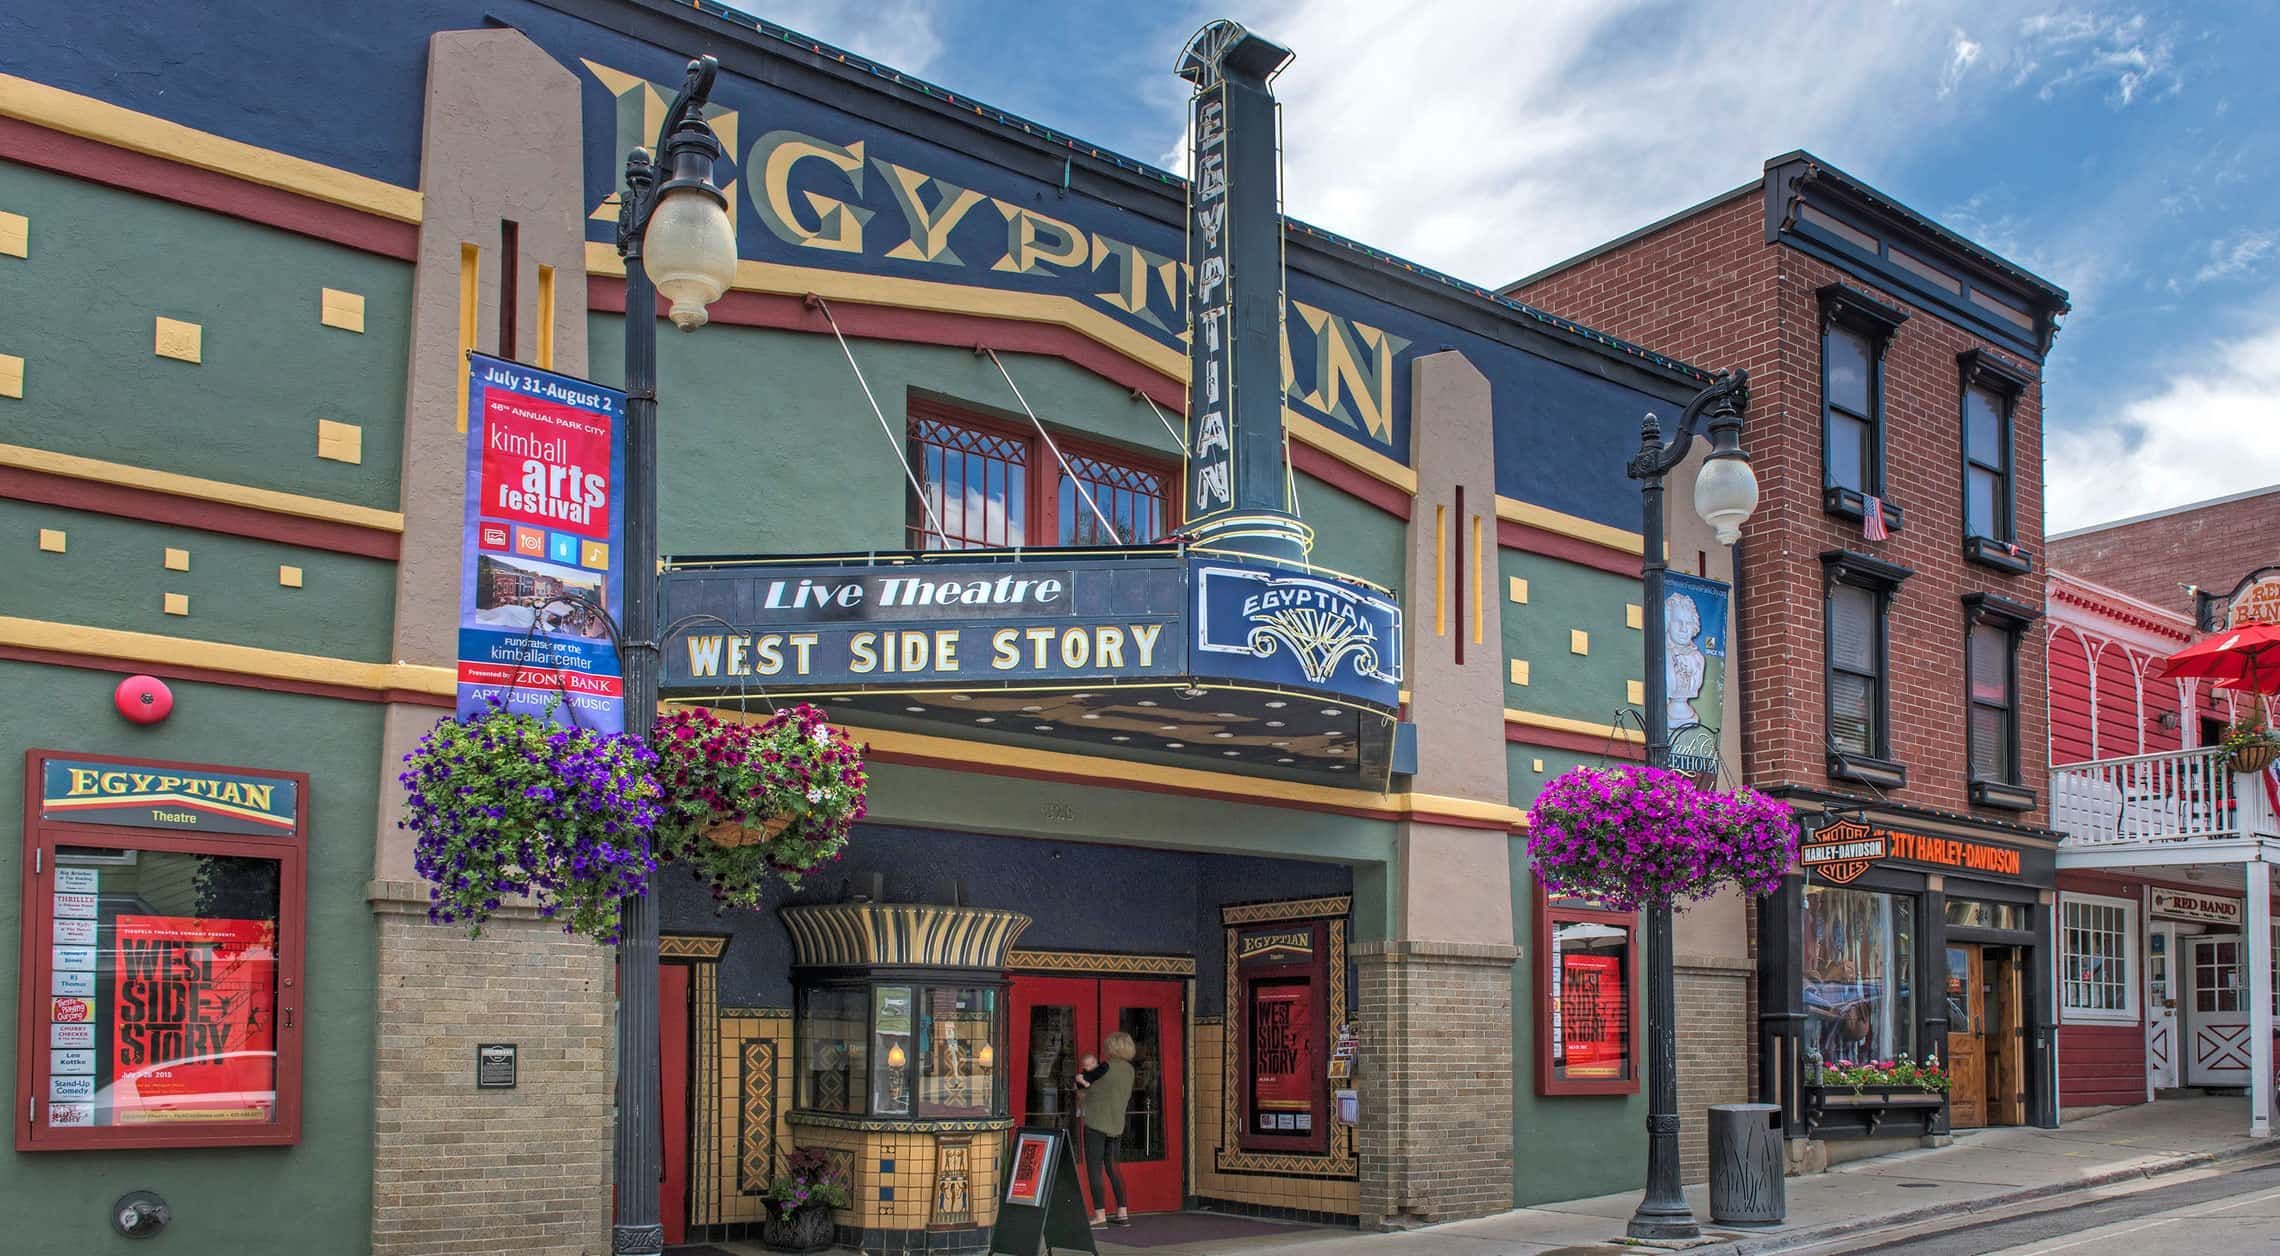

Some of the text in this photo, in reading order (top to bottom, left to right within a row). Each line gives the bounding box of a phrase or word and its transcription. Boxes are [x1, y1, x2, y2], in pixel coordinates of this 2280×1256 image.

[580, 57, 1411, 446] EGYPTN
[1197, 101, 1230, 511] EGYPTIAN
[484, 367, 612, 411] July 31-August 2
[512, 407, 554, 424] ANNUAL
[556, 418, 582, 431] PARK
[584, 425, 606, 436] CITY
[491, 423, 567, 464] kimball
[522, 459, 606, 509] arts
[499, 484, 592, 525] festival
[764, 574, 1063, 610] Live Theatre
[1243, 589, 1378, 641] EGYPTIAN
[554, 643, 567, 651] for
[568, 643, 582, 654] the
[687, 623, 1163, 676] WEST SIDE STORY
[468, 669, 499, 678] Presented
[517, 671, 566, 686] ZIONS
[571, 675, 611, 692] BANK
[66, 767, 275, 811] EGYPTIAN
[152, 810, 197, 824] Theatre
[1823, 826, 1863, 841] MOTOR
[1804, 841, 1882, 862] HARLEY-DAVIDSON
[1917, 836, 2020, 875] HARLEY-DAVIDSON
[1822, 861, 1864, 881] CYCLES
[2173, 896, 2197, 910] RED
[2200, 900, 2236, 915] BANJO
[1244, 932, 1309, 953] EGYPTIAN
[121, 938, 223, 981] WEST
[1567, 968, 1603, 993] WEST
[120, 981, 214, 1022] SIDE
[1258, 1001, 1294, 1025] WEST
[1567, 993, 1600, 1017] SIDE
[1258, 1025, 1289, 1050] SIDE
[1568, 1017, 1606, 1042] STORY
[120, 1022, 232, 1066] STORY
[1258, 1050, 1297, 1075] STORY
[55, 1080, 90, 1088] Stand-Up
[56, 1087, 88, 1095] Comedy
